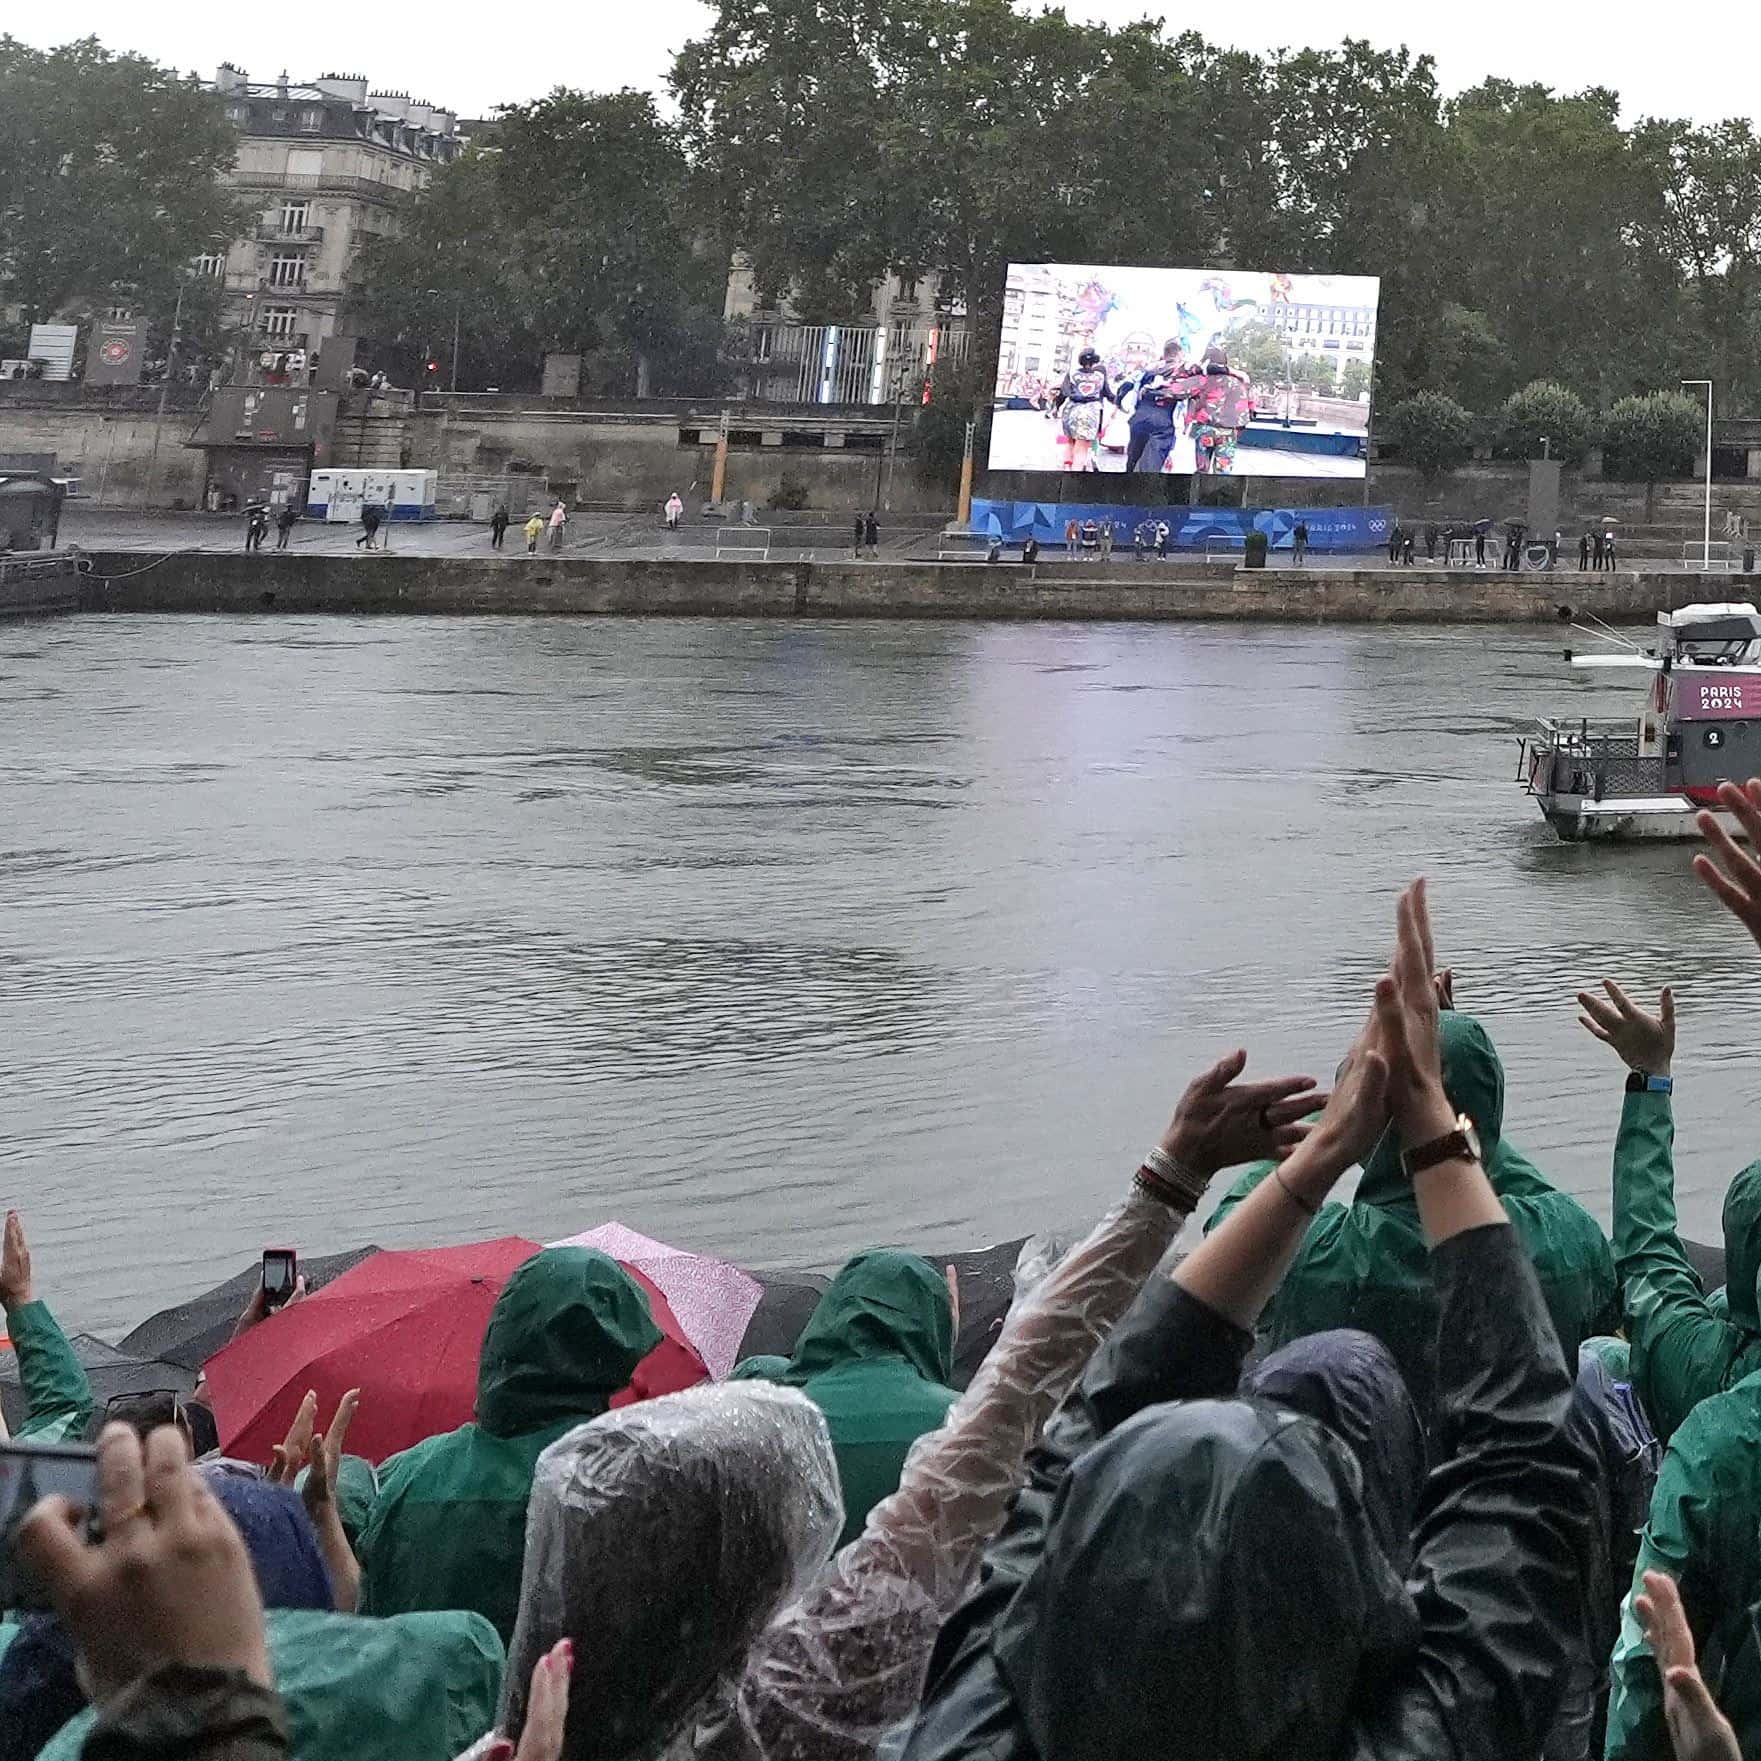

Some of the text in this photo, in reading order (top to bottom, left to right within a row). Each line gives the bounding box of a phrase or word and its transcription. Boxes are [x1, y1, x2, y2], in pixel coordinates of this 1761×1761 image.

[1700, 686, 1742, 698] PARIS
[1701, 698, 1743, 710] 2024
[1708, 732, 1719, 745] 2
